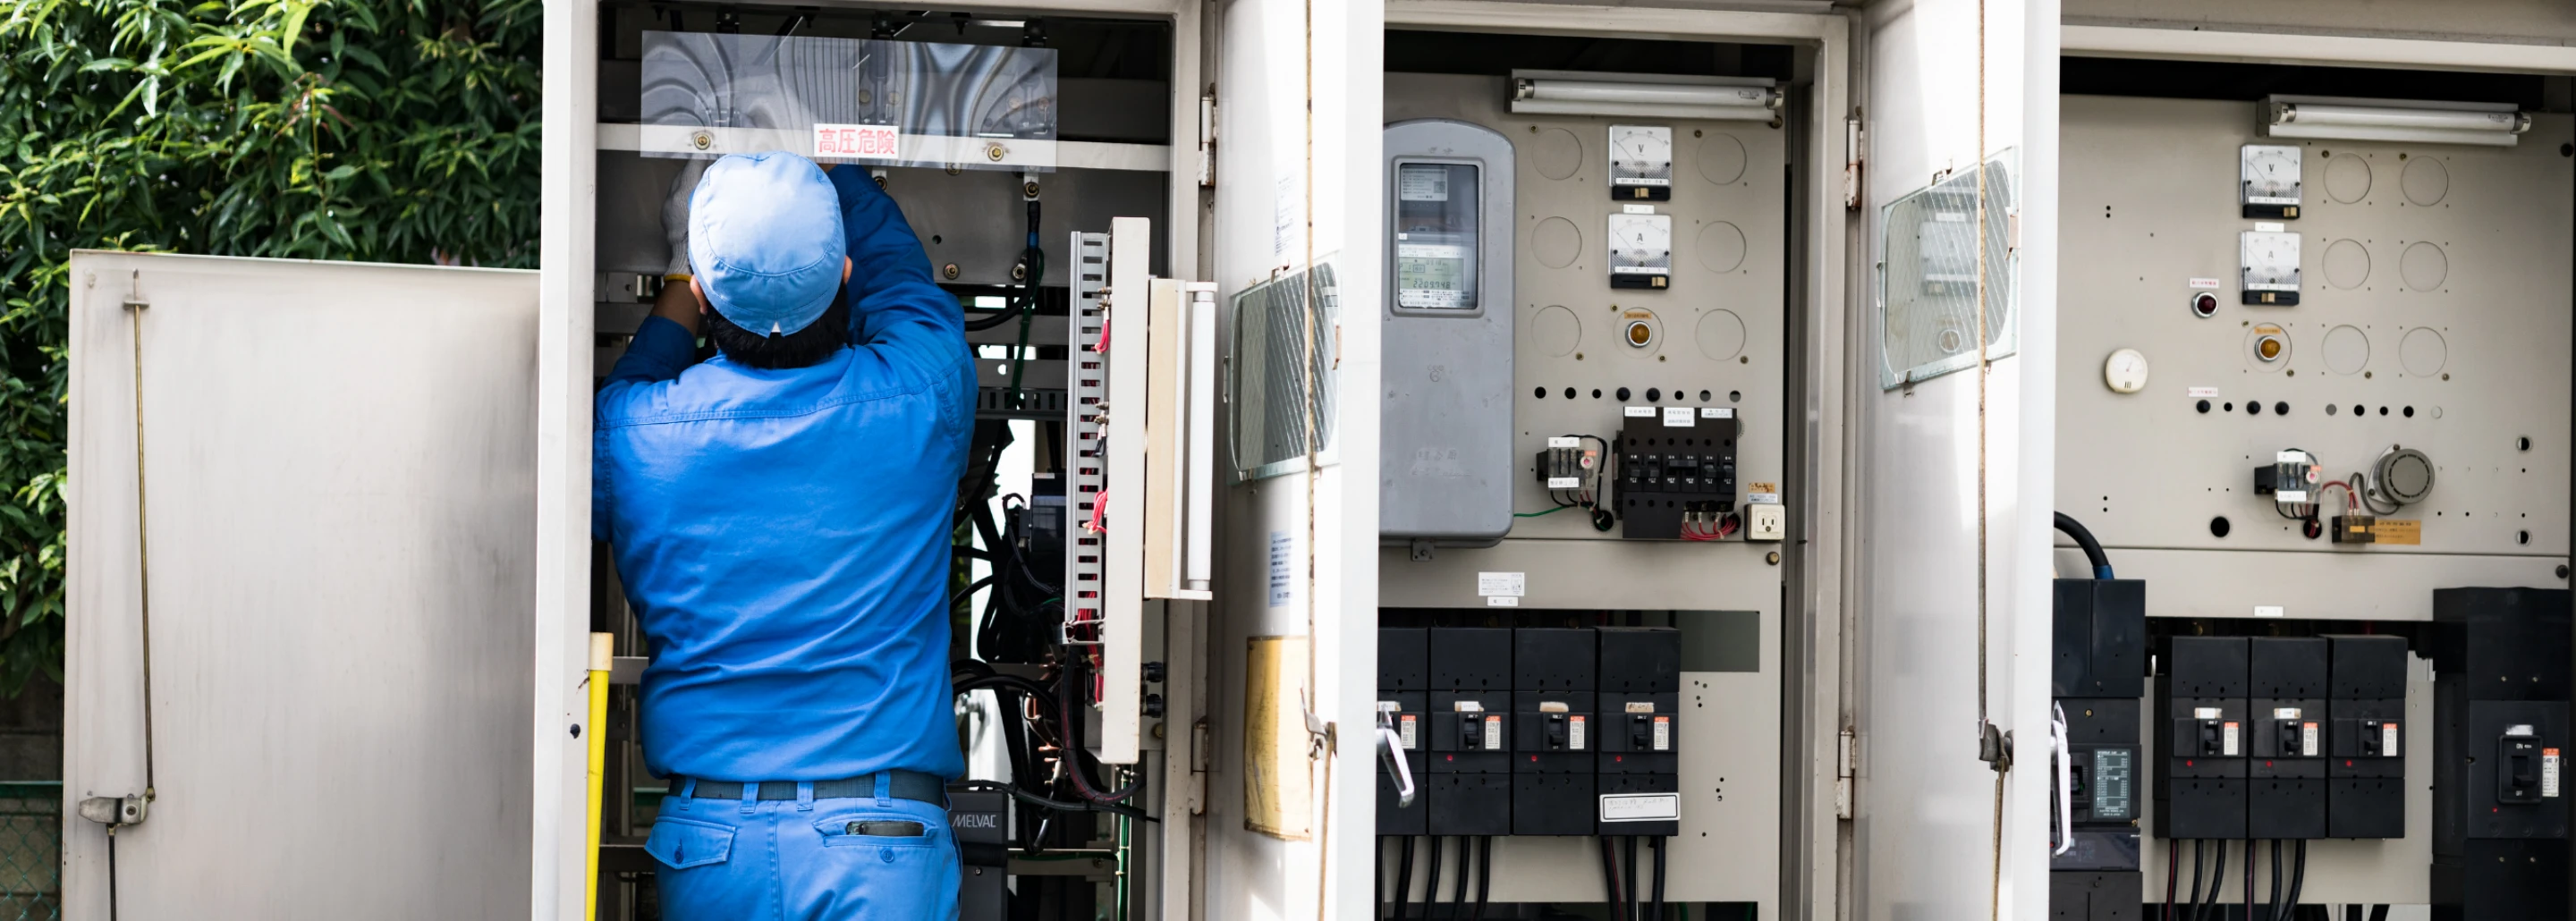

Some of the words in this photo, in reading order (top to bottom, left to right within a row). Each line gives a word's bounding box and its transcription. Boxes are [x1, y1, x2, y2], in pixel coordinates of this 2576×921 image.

[818, 128, 895, 155] 高圧危険
[1638, 144, 1644, 154] V
[2268, 164, 2275, 173] V
[1636, 232, 1644, 242] A
[2267, 250, 2275, 259] A
[952, 814, 996, 828] MELVAC
